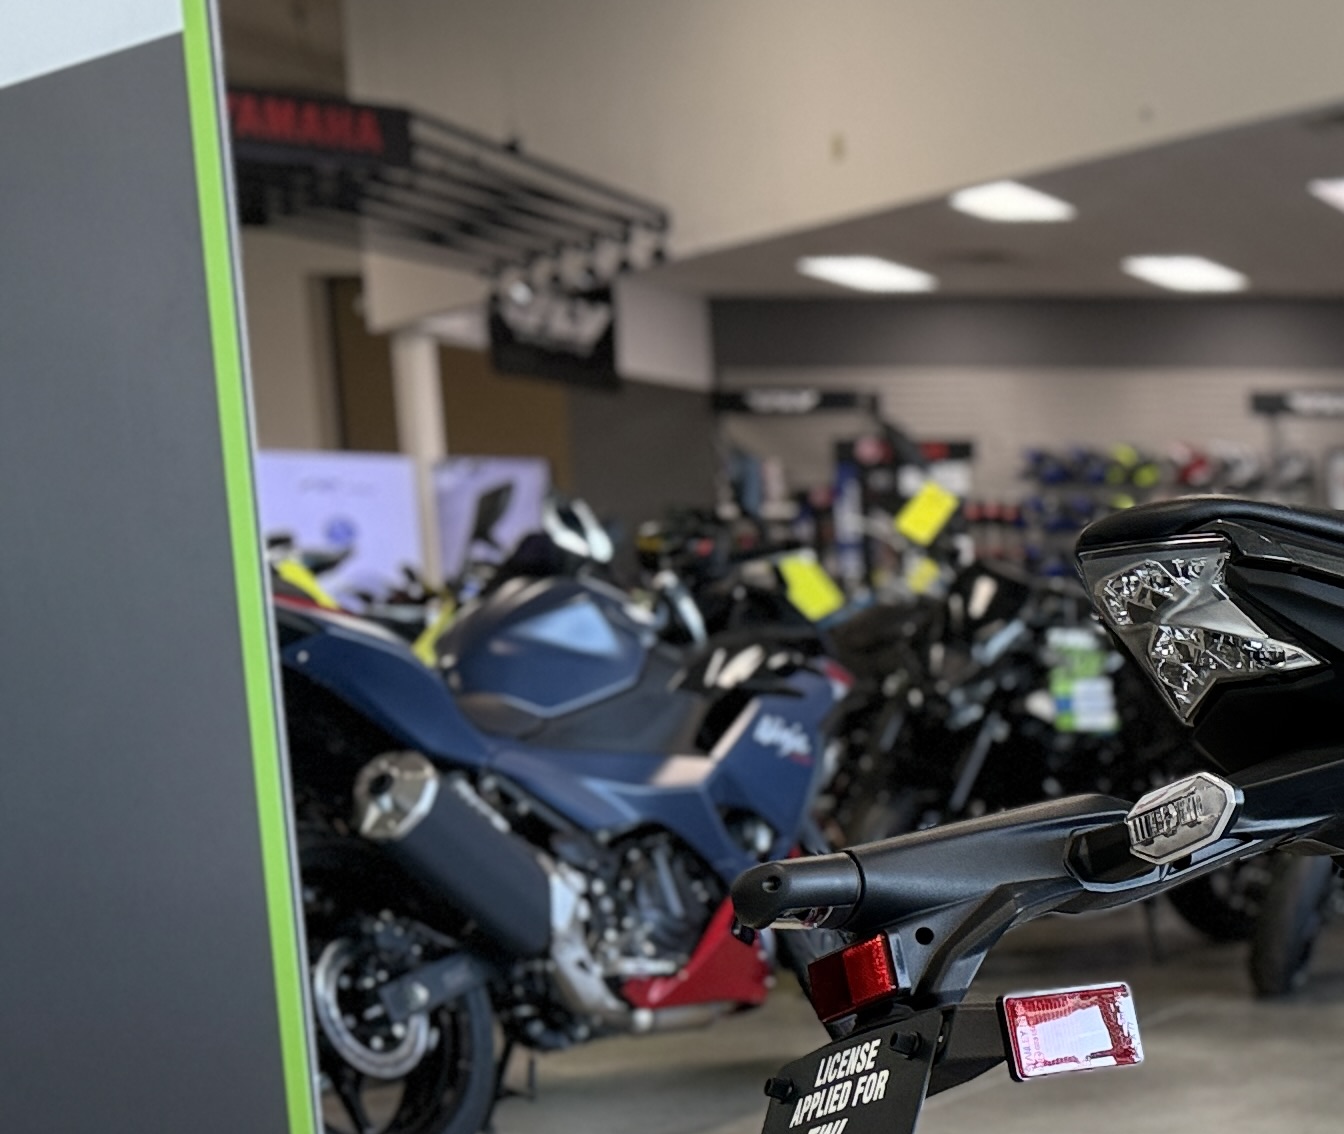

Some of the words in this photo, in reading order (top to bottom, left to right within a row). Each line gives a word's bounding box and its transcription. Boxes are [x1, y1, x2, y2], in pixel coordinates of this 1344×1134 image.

[814, 1038, 881, 1088] LICENSE
[788, 1080, 853, 1128] APPLIED
[851, 1069, 890, 1107] FOR
